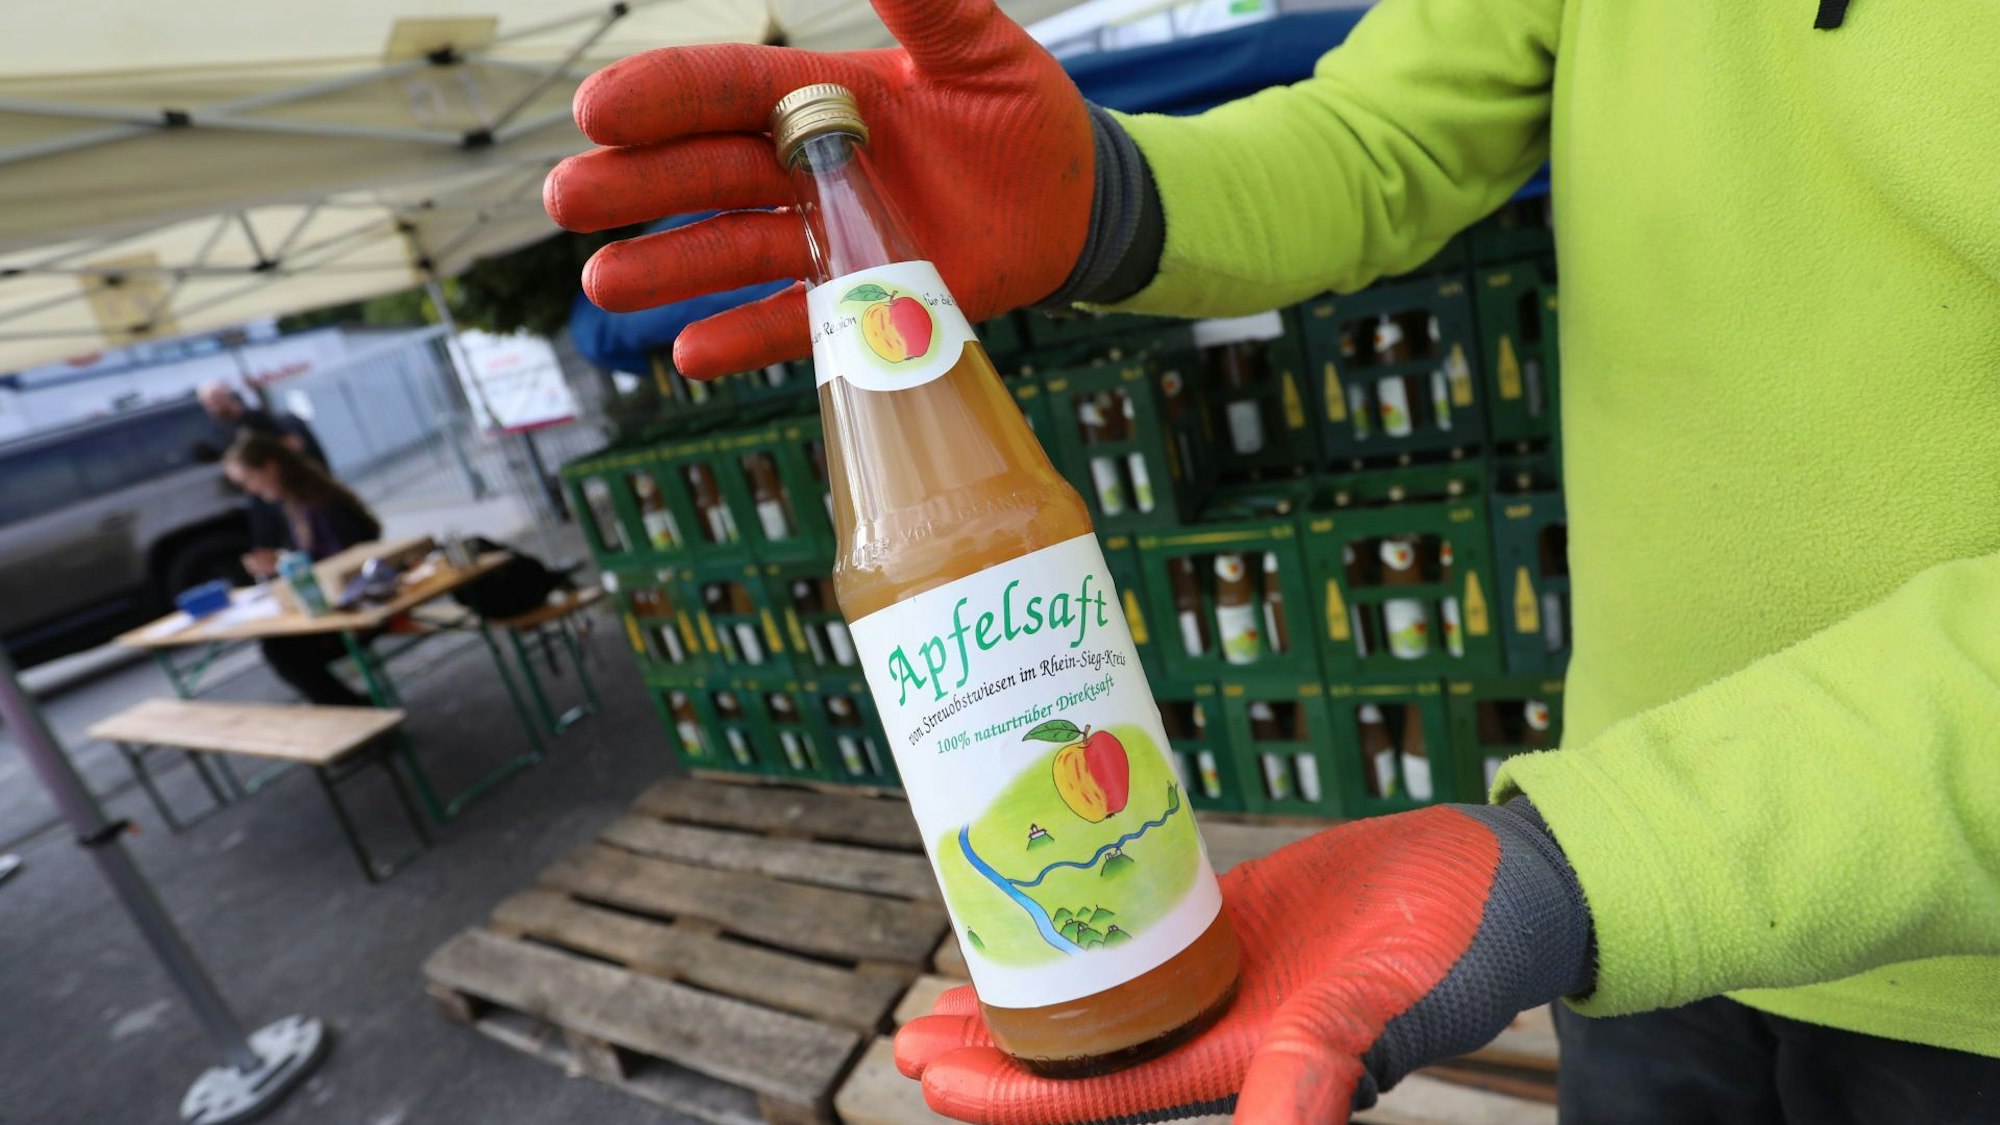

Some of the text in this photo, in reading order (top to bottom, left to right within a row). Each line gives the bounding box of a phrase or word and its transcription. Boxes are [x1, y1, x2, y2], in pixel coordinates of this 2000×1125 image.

[888, 574, 1109, 707] Apfelsaft
[908, 649, 1126, 746] von Streuobstwiesen im Rhein-Sieg-Kreis
[937, 673, 1115, 754] 100% naturtrüber Direktsaft
